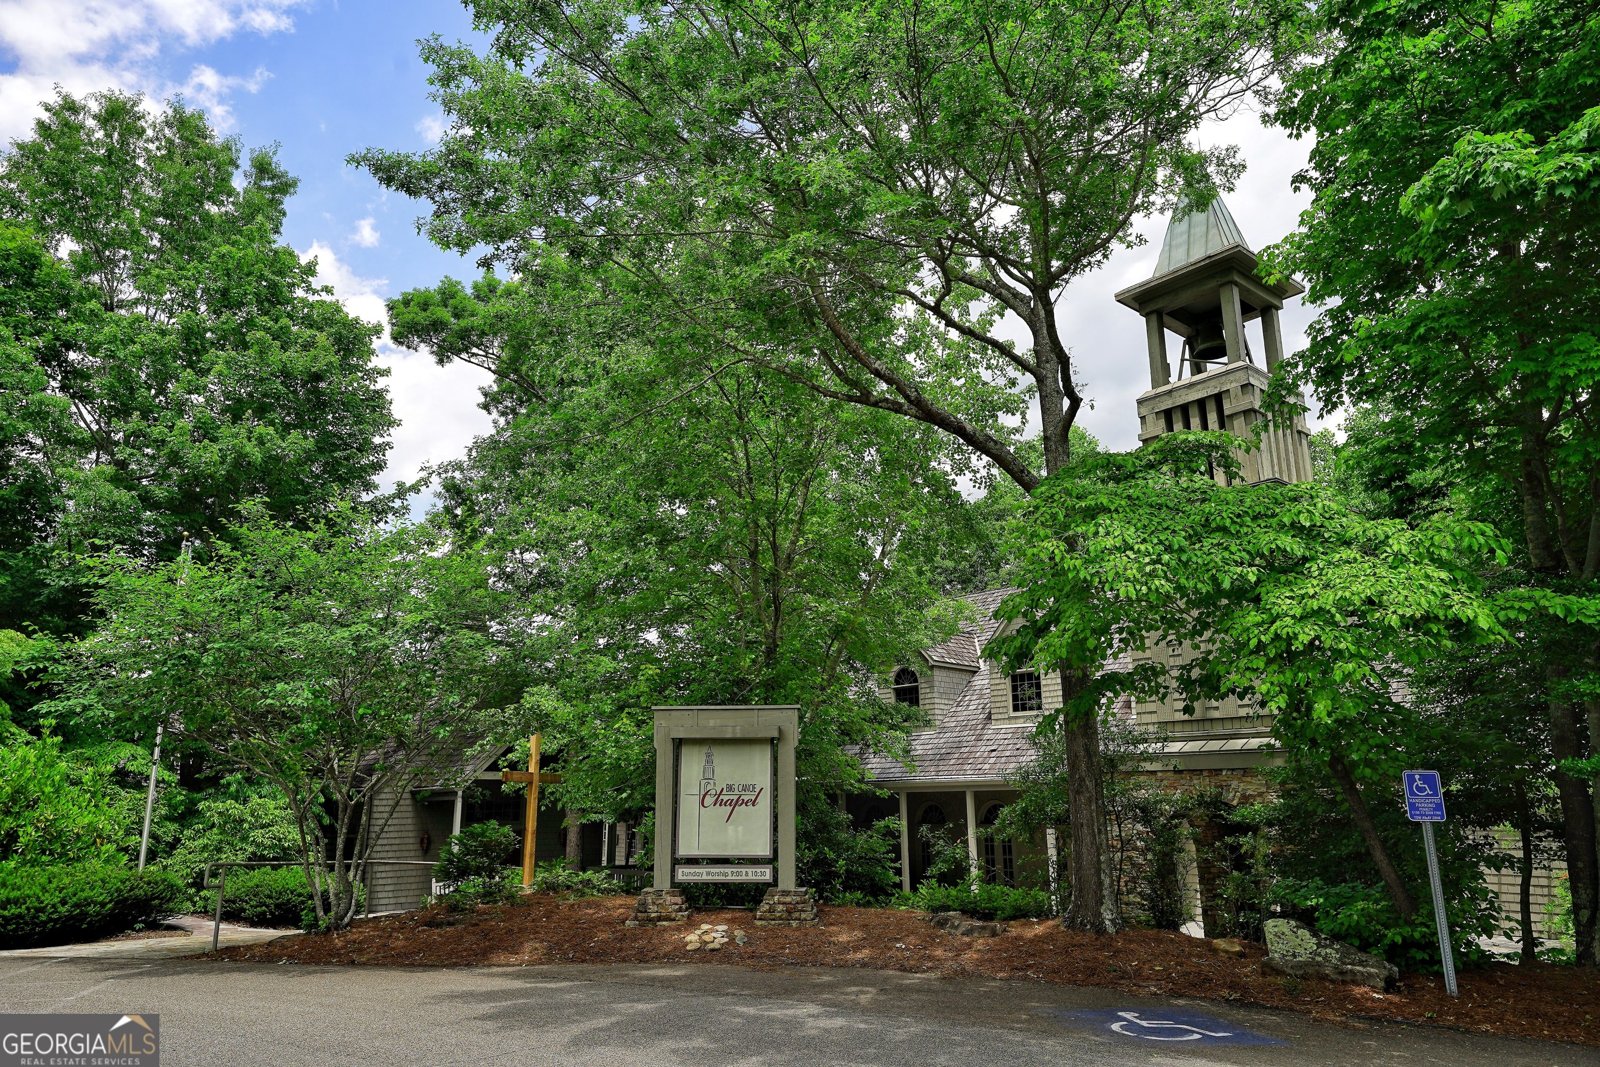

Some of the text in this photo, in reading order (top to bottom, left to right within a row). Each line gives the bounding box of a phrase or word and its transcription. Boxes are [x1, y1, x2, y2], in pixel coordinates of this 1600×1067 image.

[726, 784, 756, 792] BIG CANOE
[701, 787, 764, 823] Chapel
